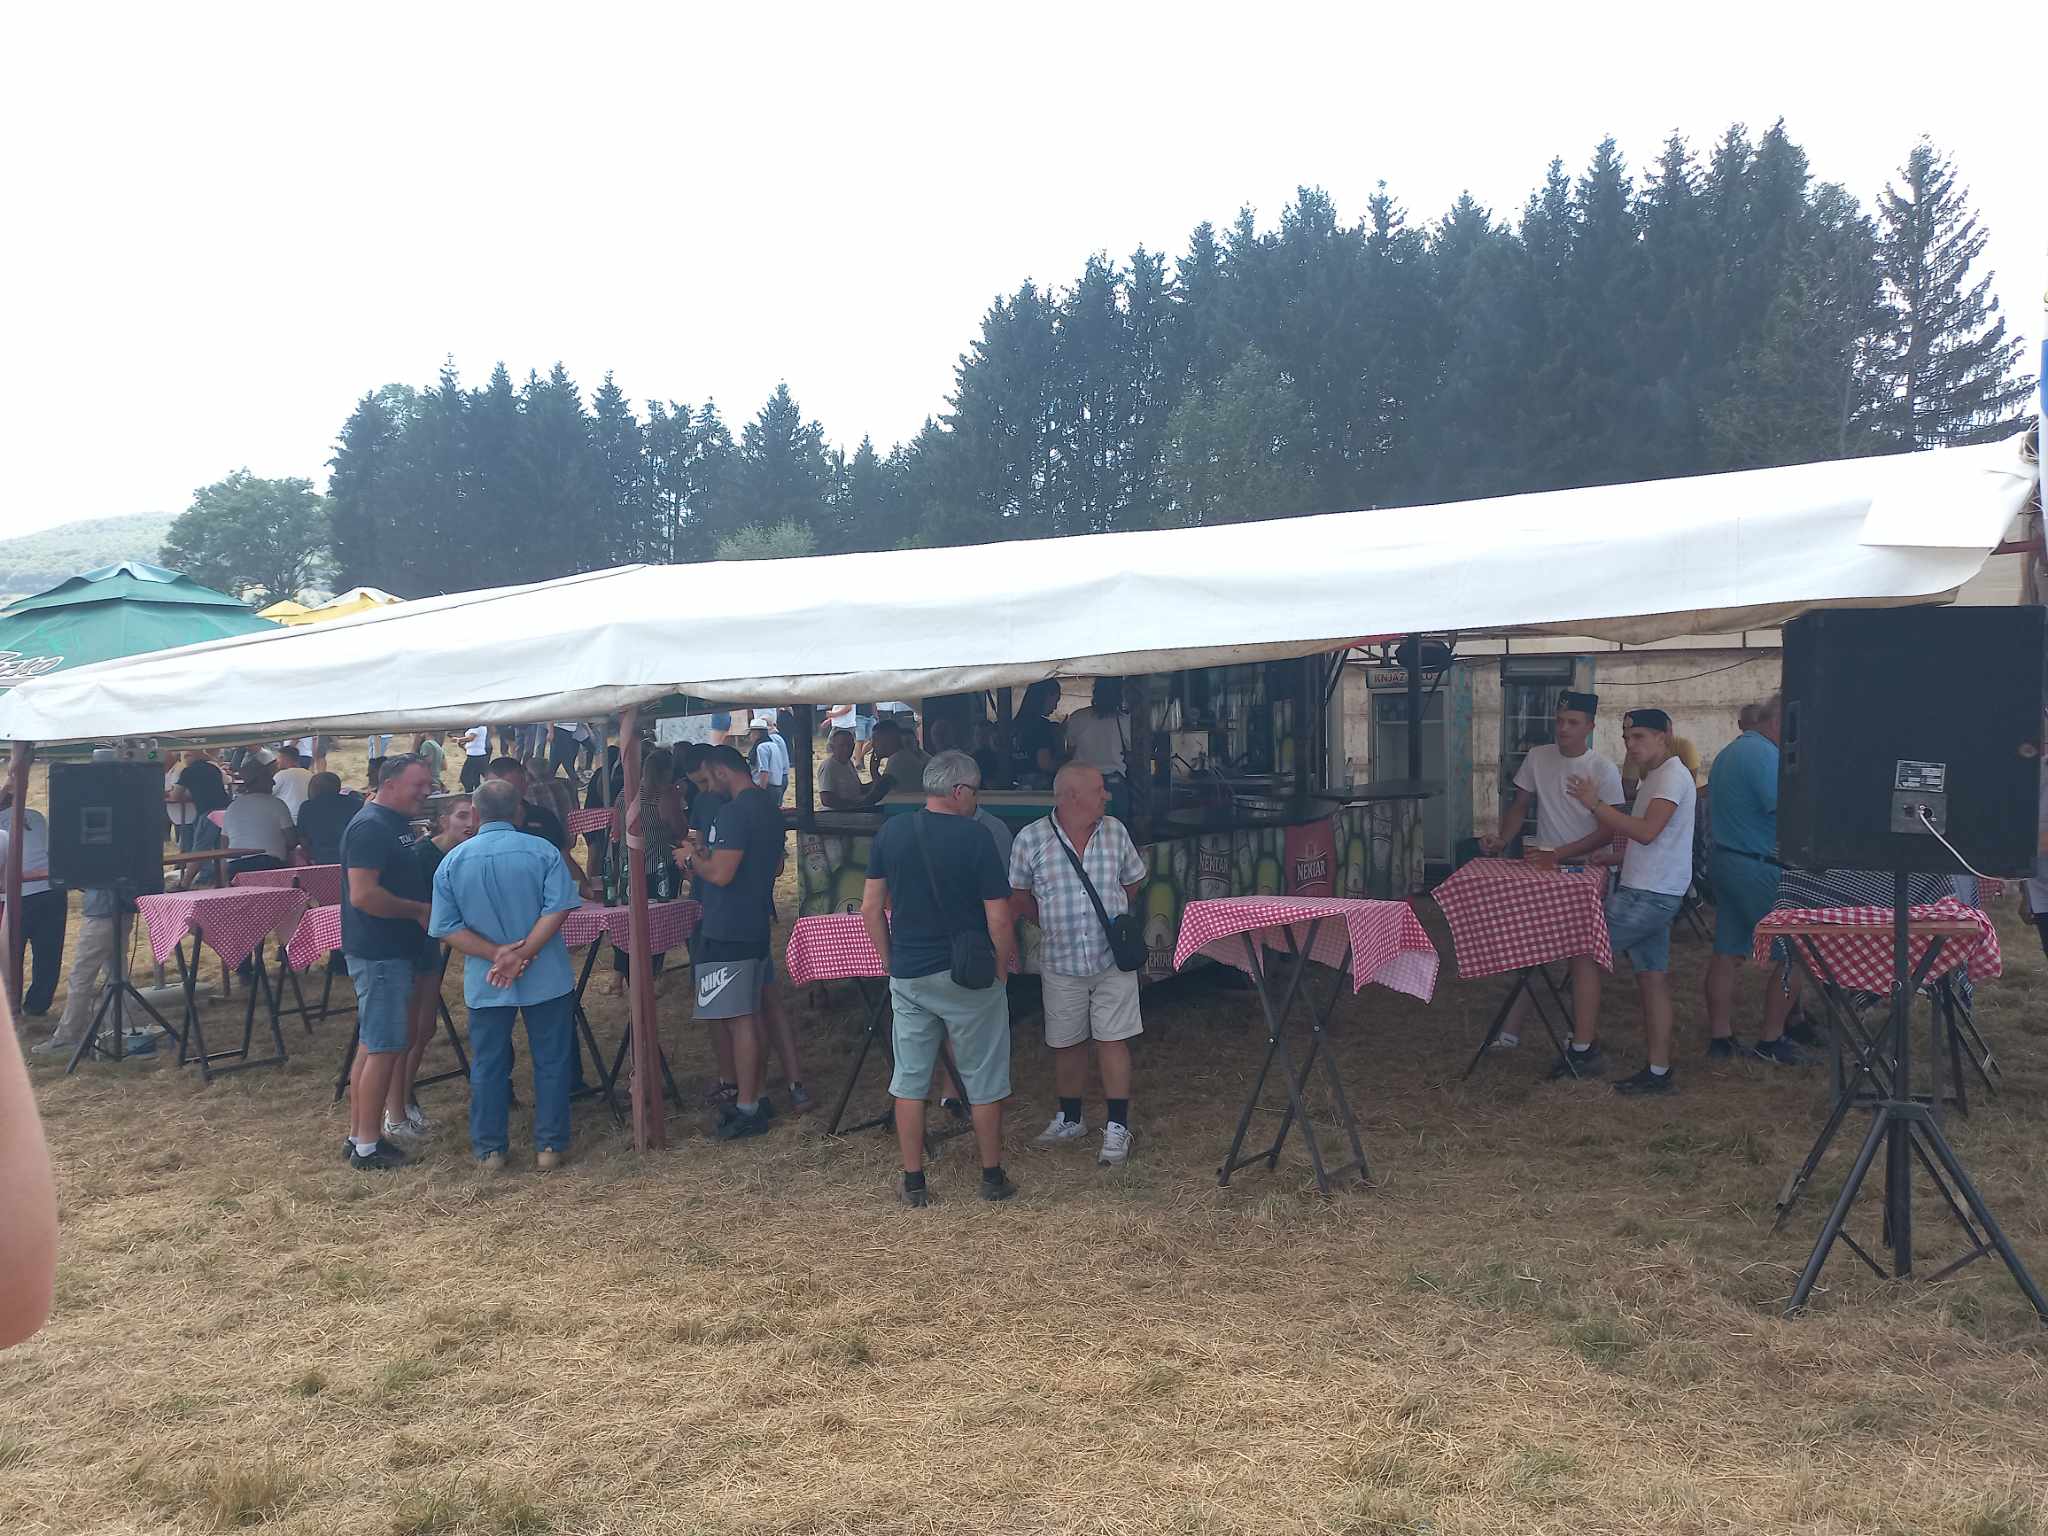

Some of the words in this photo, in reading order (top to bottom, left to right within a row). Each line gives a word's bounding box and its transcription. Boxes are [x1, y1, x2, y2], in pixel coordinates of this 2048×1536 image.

[1199, 852, 1229, 873] NEKTAR
[1297, 861, 1326, 881] NEKTAR
[700, 966, 729, 994] NIKE
